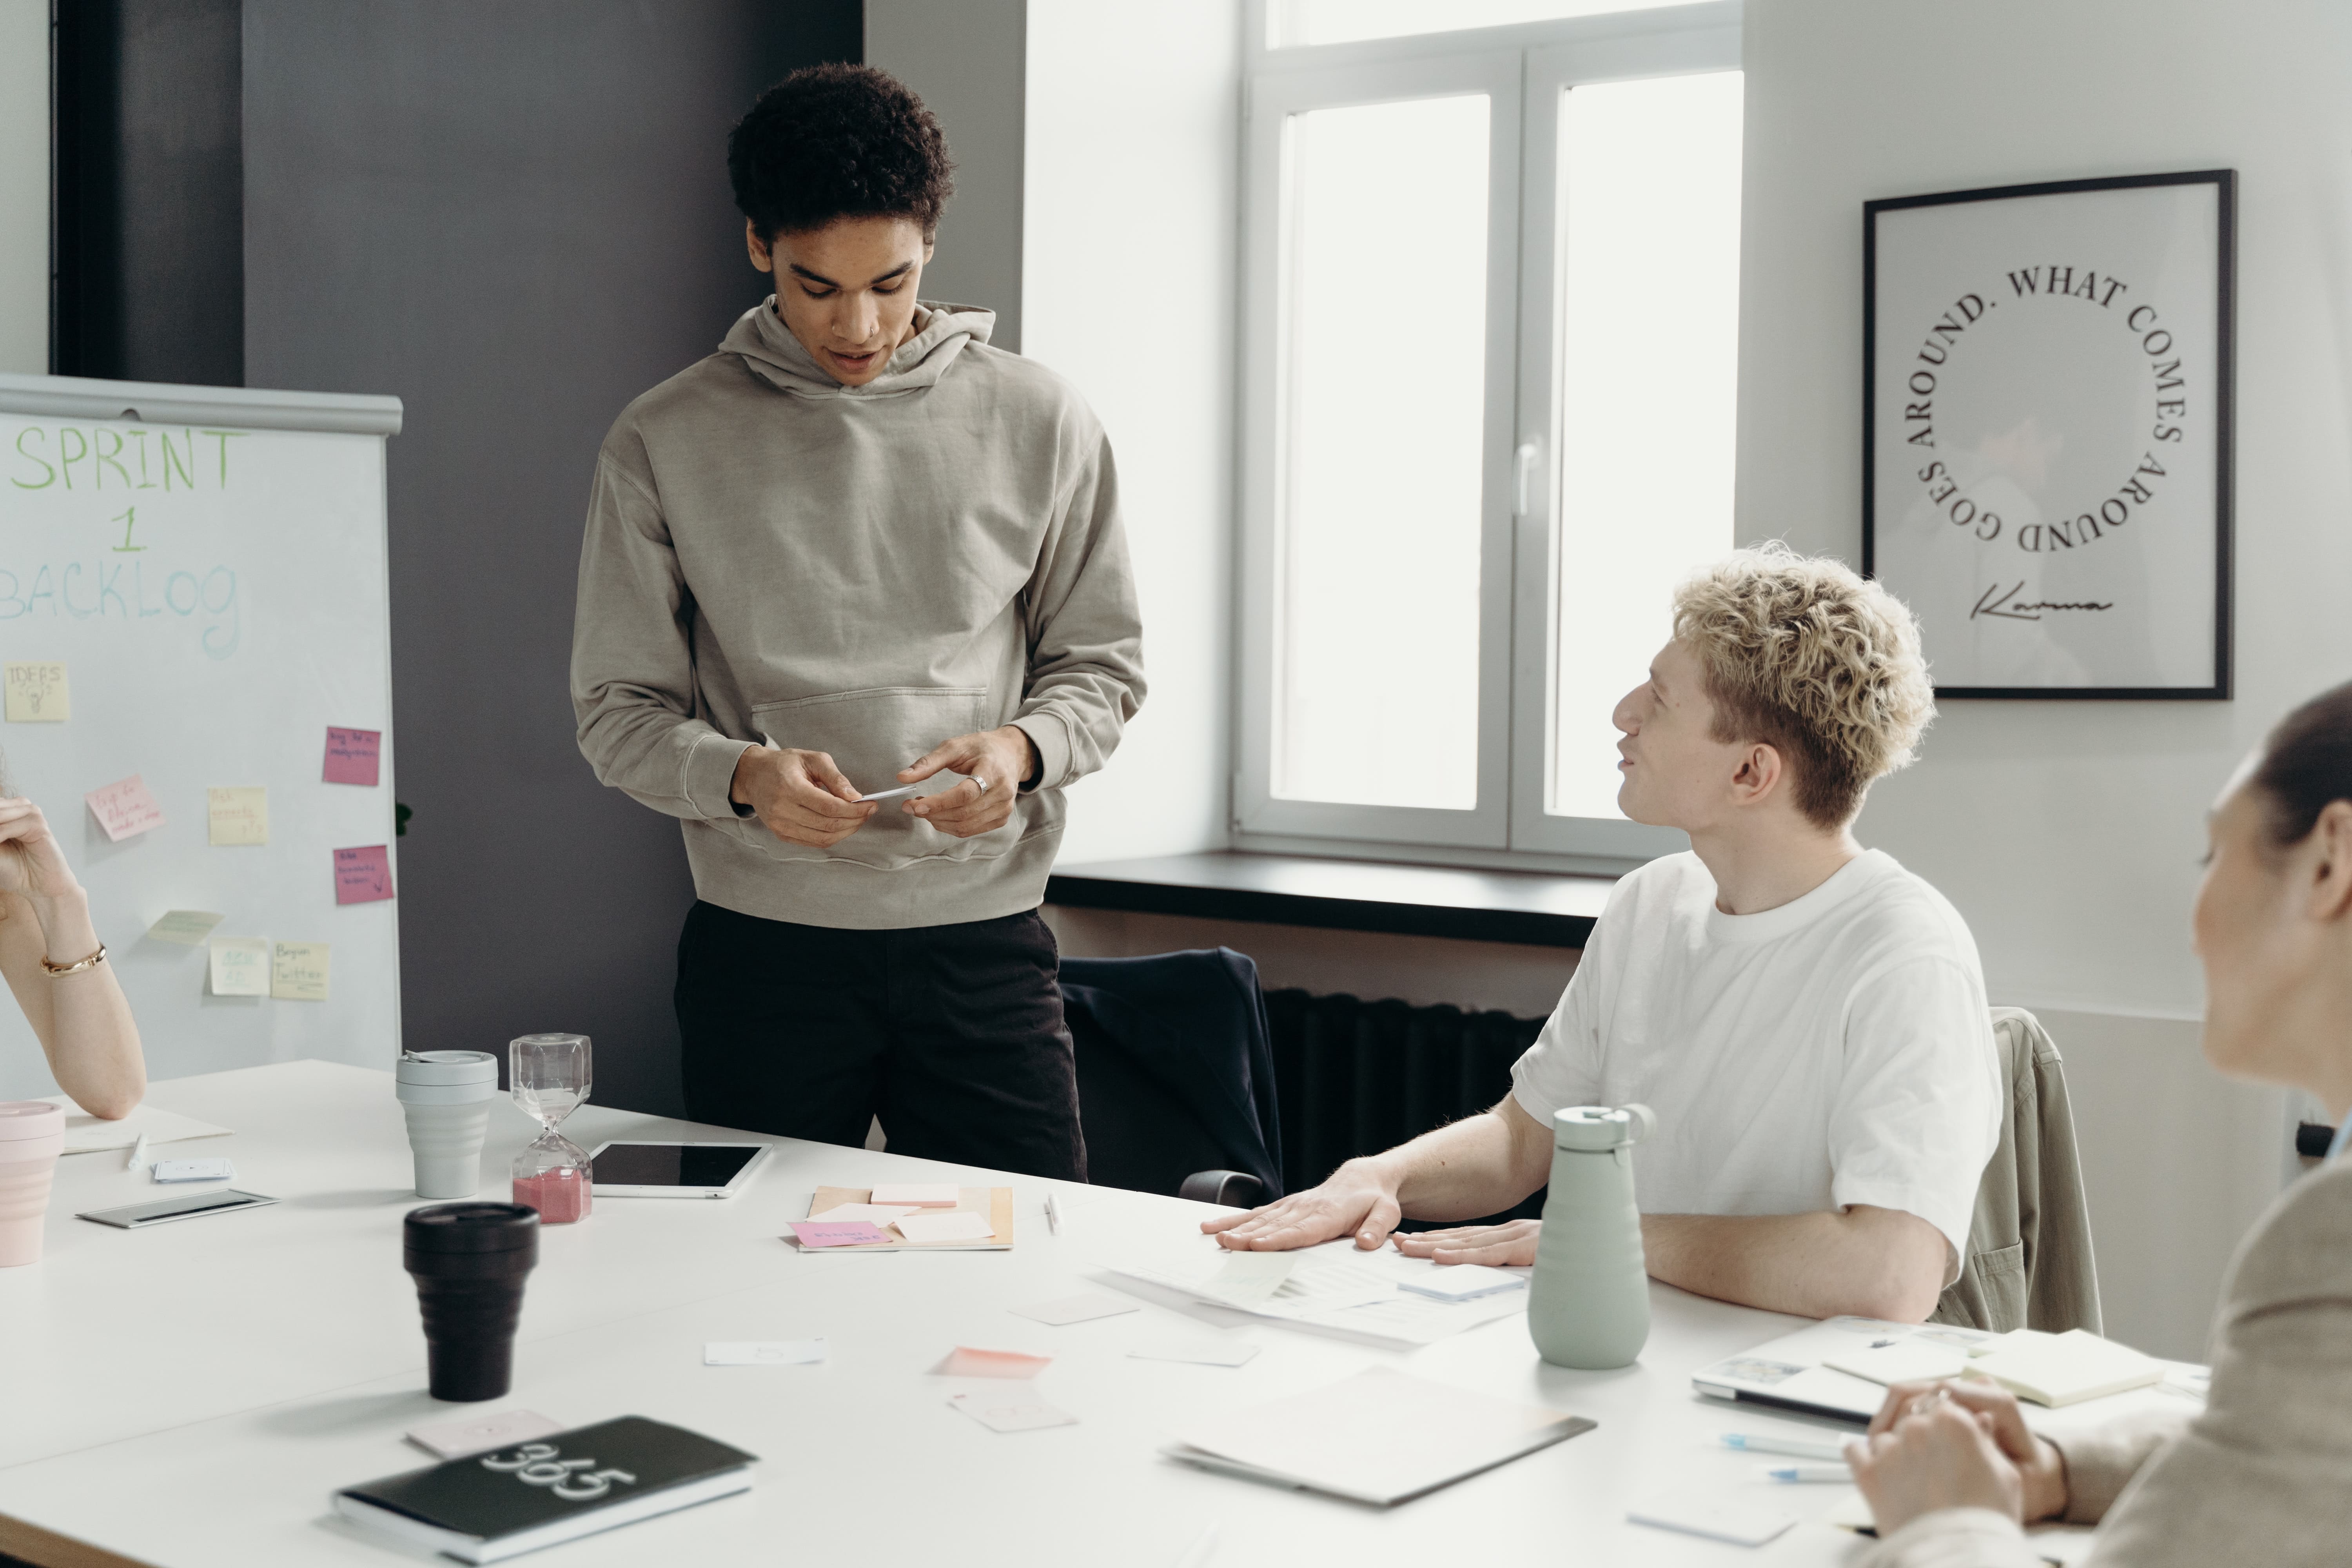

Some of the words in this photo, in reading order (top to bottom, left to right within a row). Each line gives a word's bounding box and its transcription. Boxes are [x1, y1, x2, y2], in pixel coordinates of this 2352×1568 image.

[2007, 266, 2127, 308] WHAT
[1905, 294, 1996, 448] AROUND.
[2127, 305, 2185, 442] COMES
[10, 426, 251, 492] SPRINT
[111, 506, 147, 552] 1
[1918, 462, 2002, 541] GOES
[2018, 452, 2166, 552] AROUND
[481, 1443, 637, 1501] 365
